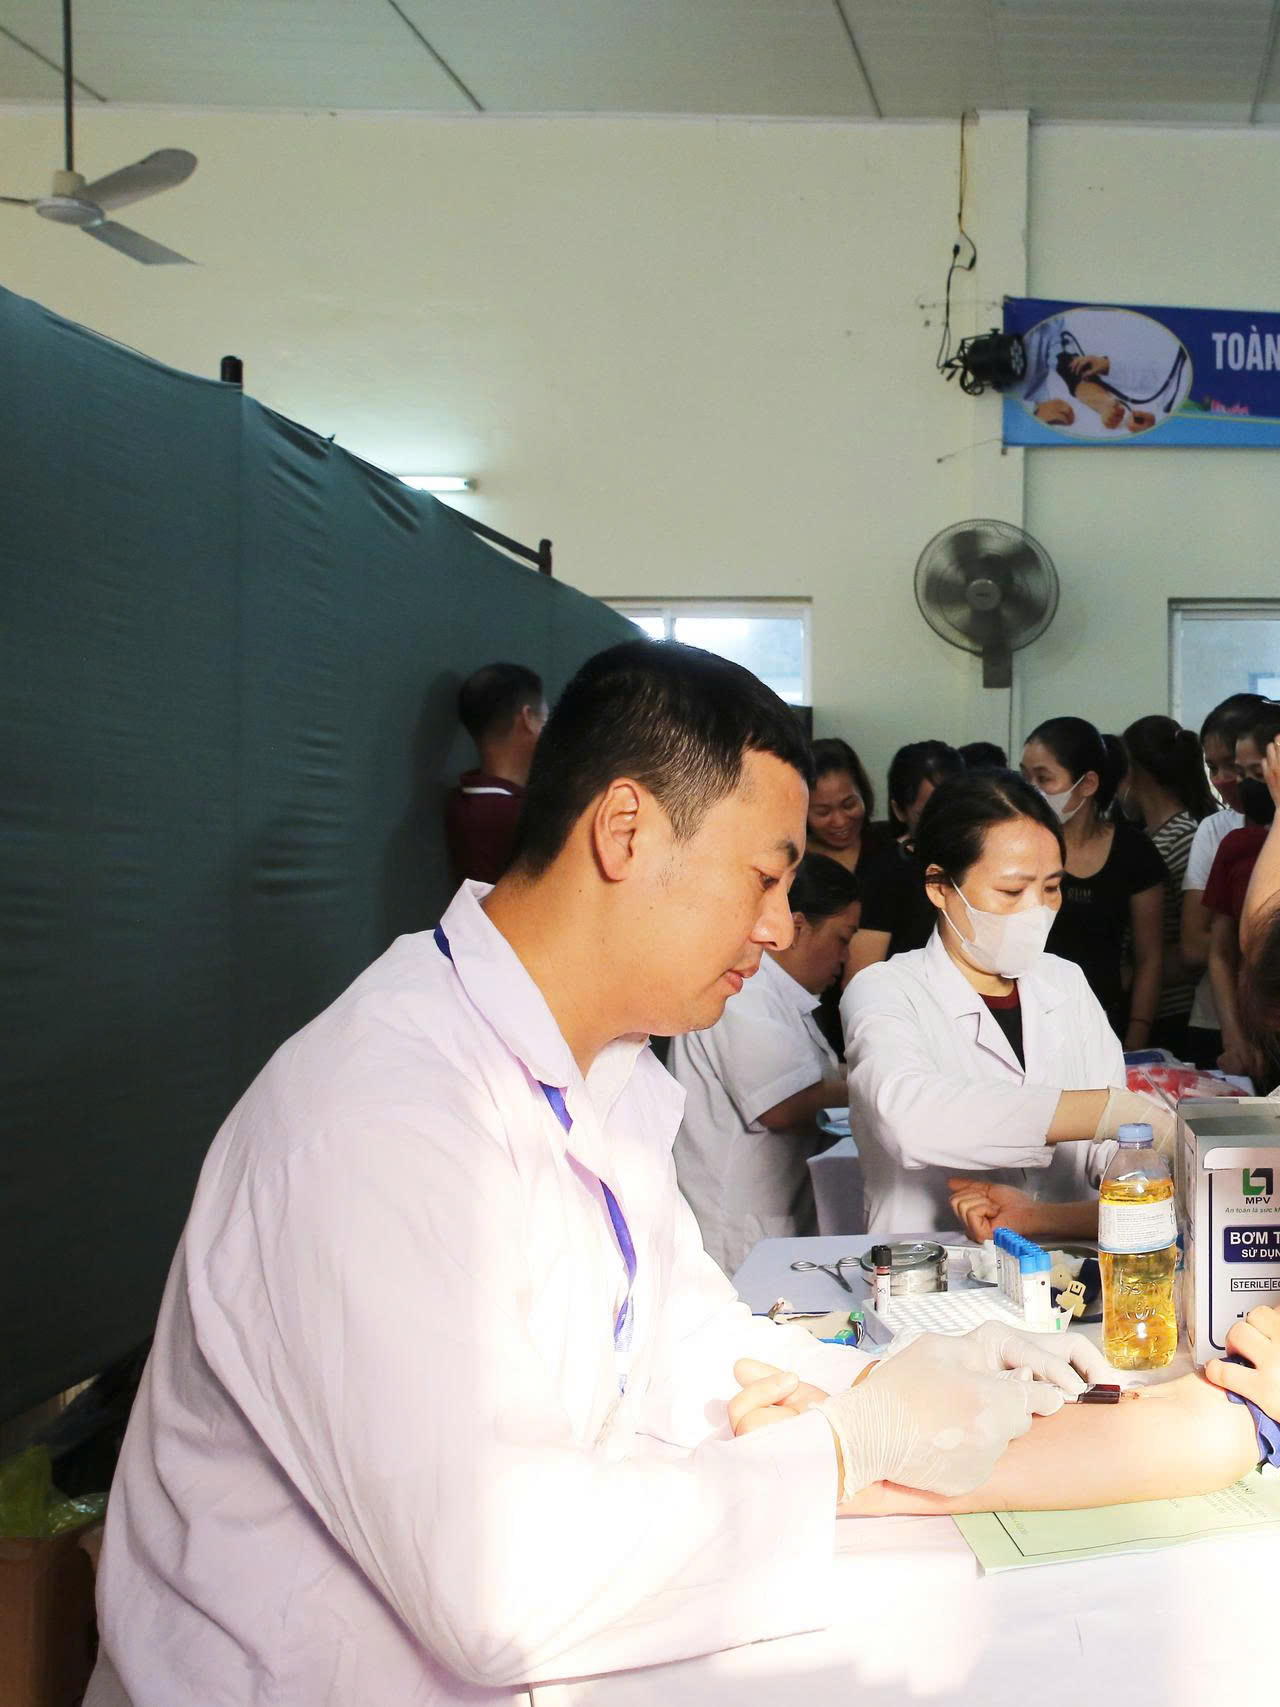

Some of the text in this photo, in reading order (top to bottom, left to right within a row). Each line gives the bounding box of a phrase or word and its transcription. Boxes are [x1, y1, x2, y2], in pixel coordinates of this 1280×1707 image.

[1245, 1196, 1271, 1205] MPV
[1230, 1231, 1268, 1245] BƠM
[1241, 1247, 1258, 1258] SỬ
[1233, 1280, 1270, 1289] STERILE
